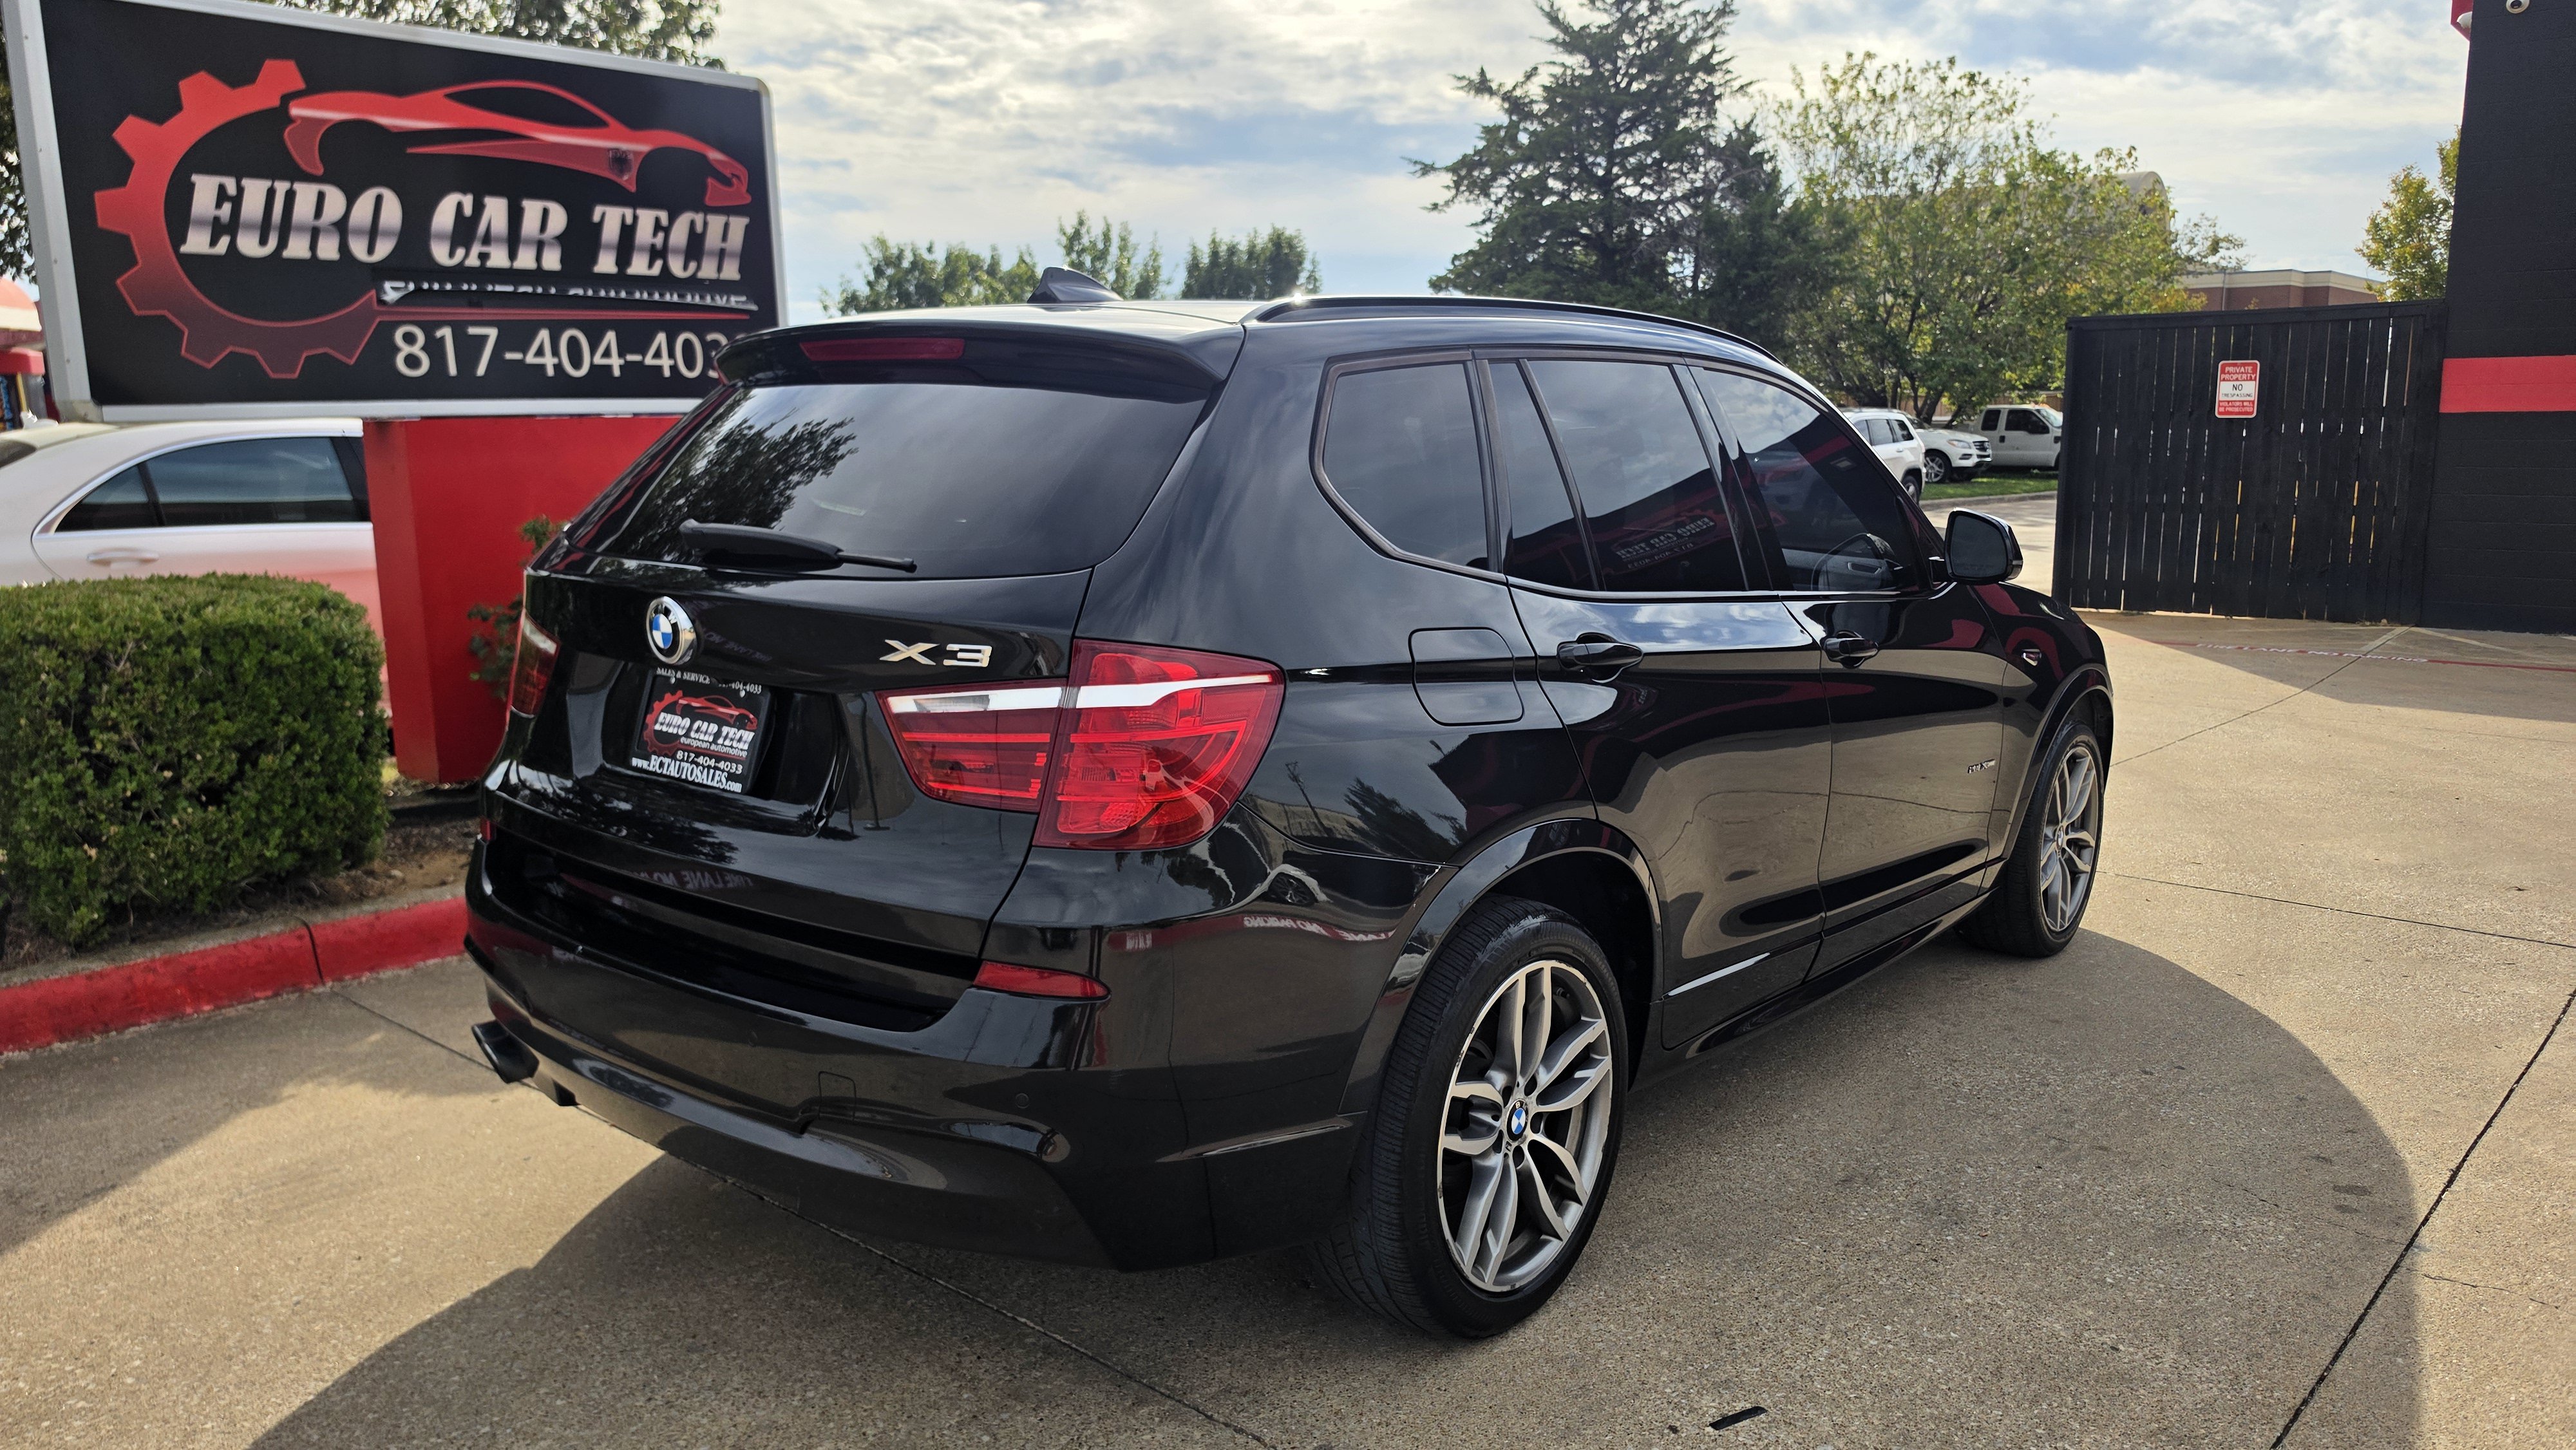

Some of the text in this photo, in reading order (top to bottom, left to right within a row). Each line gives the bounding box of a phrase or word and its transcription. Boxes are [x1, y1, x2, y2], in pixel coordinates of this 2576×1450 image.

[180, 173, 750, 281] EURO CAR TECH
[393, 323, 746, 379] 817-404-403
[880, 639, 992, 667] X3
[656, 667, 675, 677] SALES
[683, 672, 710, 684] SERVICE
[654, 712, 755, 749] EURO CAR TECH
[676, 750, 743, 774] 817-404-4033
[680, 737, 748, 757] european automotive
[632, 755, 742, 793] www.ECTAUTOSALES.com
